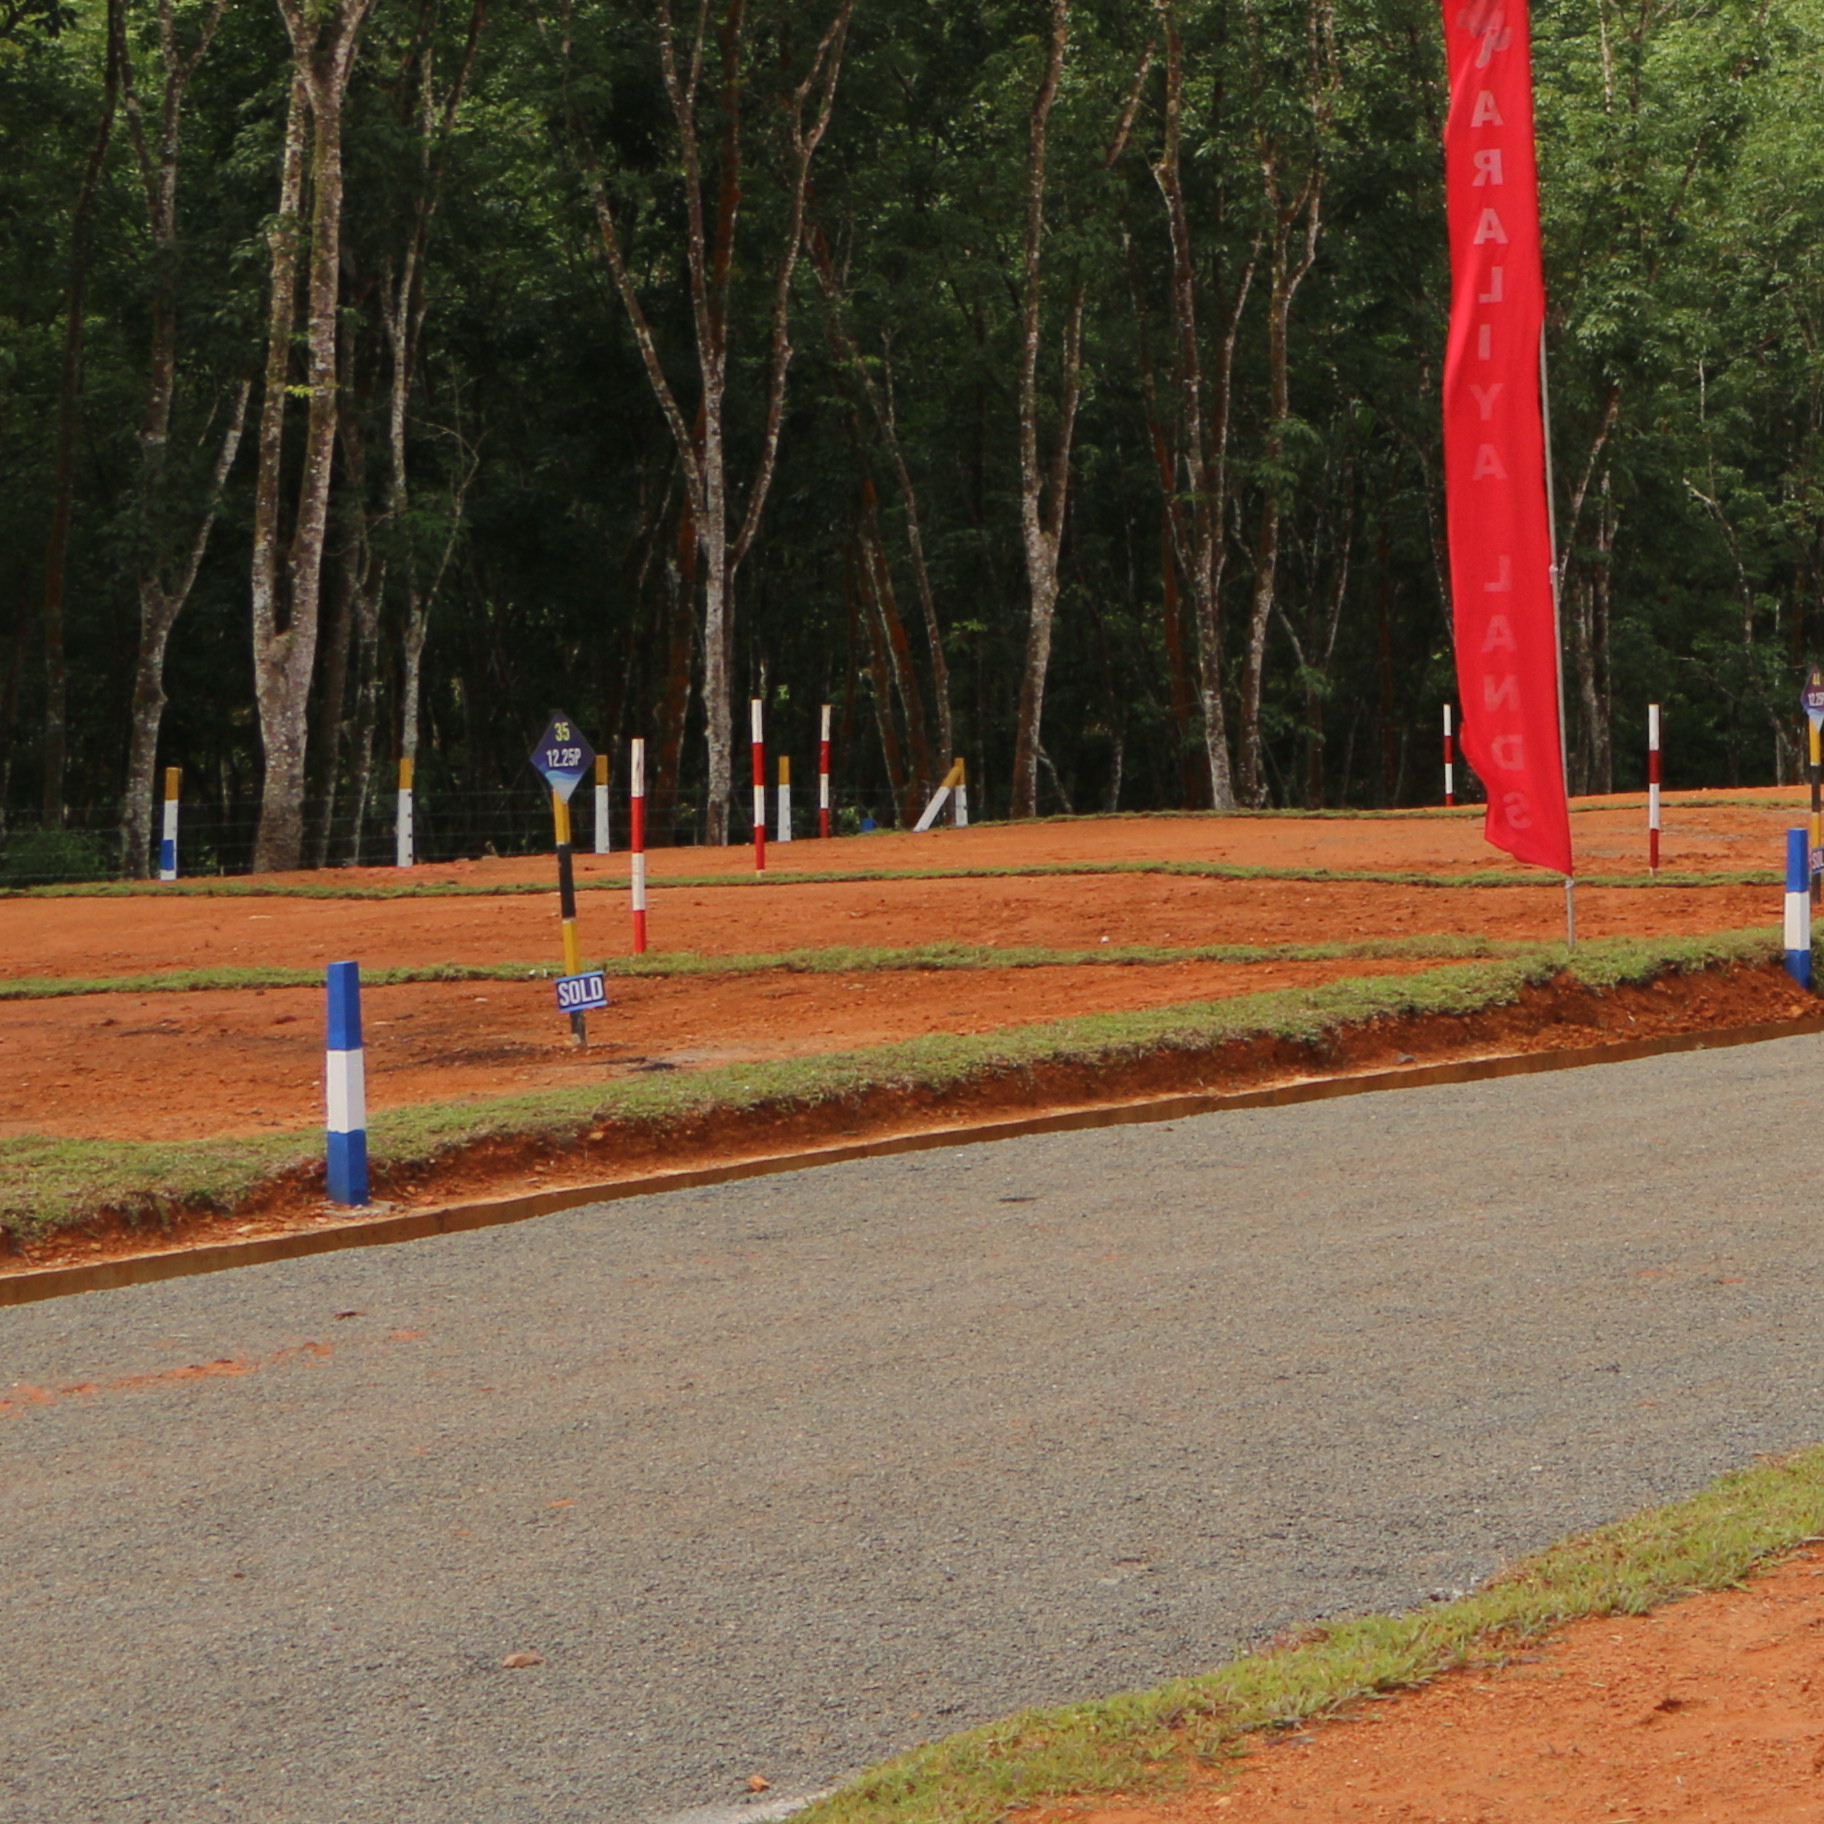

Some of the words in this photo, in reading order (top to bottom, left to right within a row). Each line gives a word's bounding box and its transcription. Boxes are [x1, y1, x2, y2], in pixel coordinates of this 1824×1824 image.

[554, 722, 570, 741] 35
[546, 748, 581, 768] 12.25P
[558, 977, 604, 1006] SOLD
